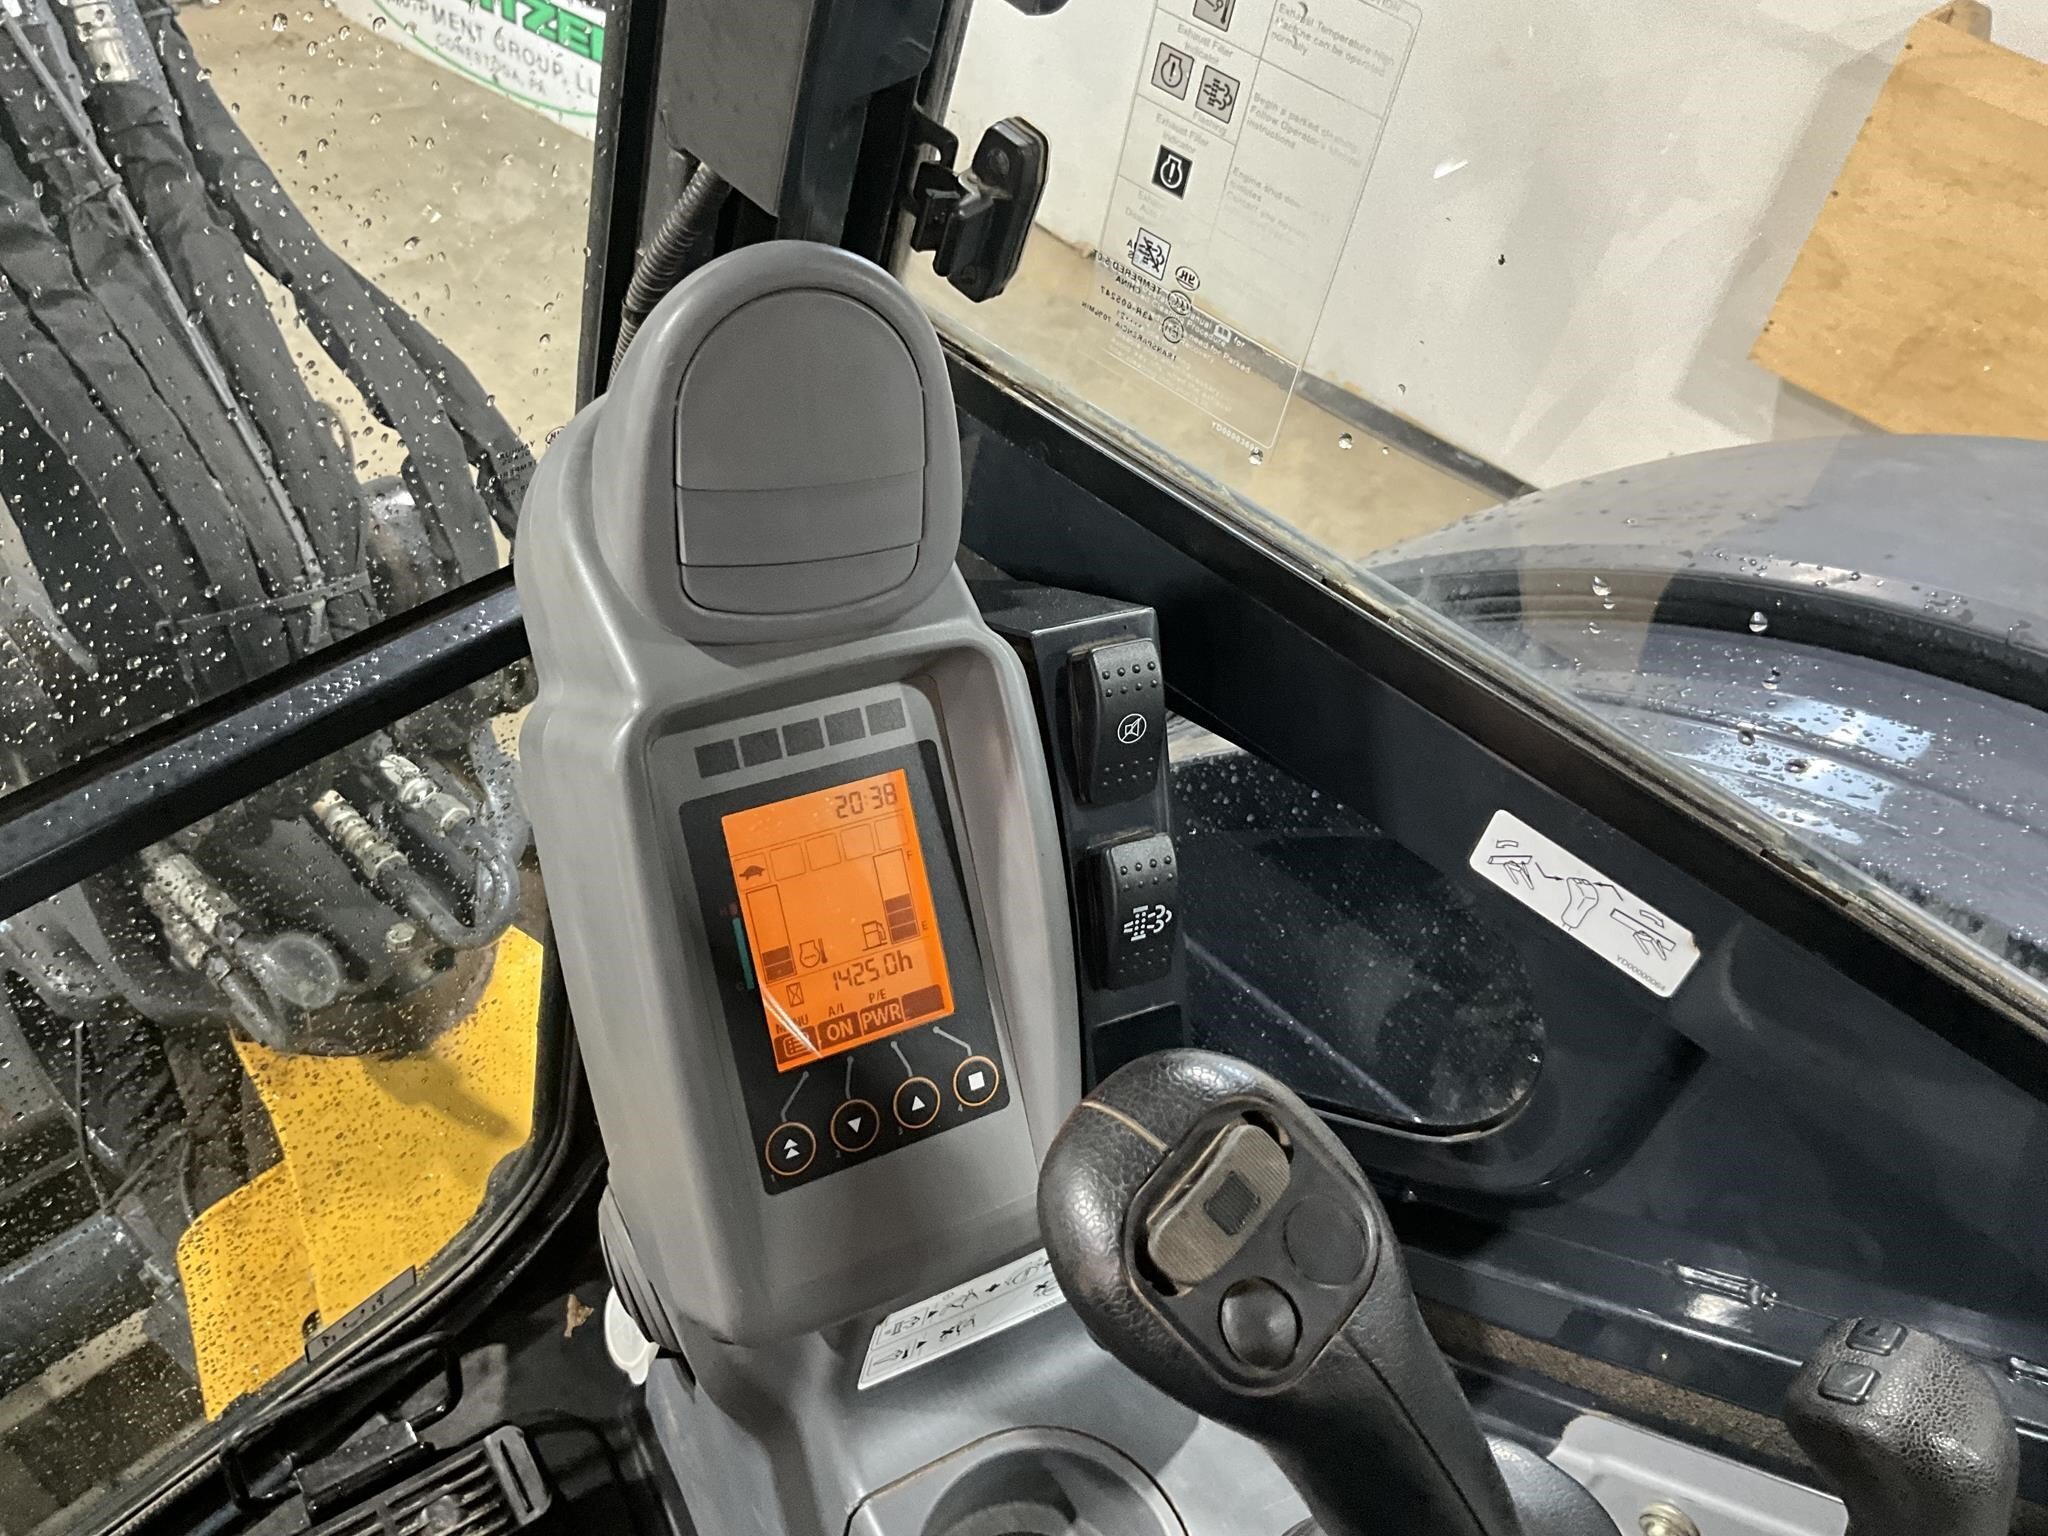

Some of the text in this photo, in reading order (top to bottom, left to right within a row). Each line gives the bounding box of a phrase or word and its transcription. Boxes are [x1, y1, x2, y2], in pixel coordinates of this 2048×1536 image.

[868, 988, 887, 1004] P/E
[775, 1014, 809, 1035] MNU
[861, 1003, 902, 1031] PWR
[826, 1018, 854, 1042] ON
